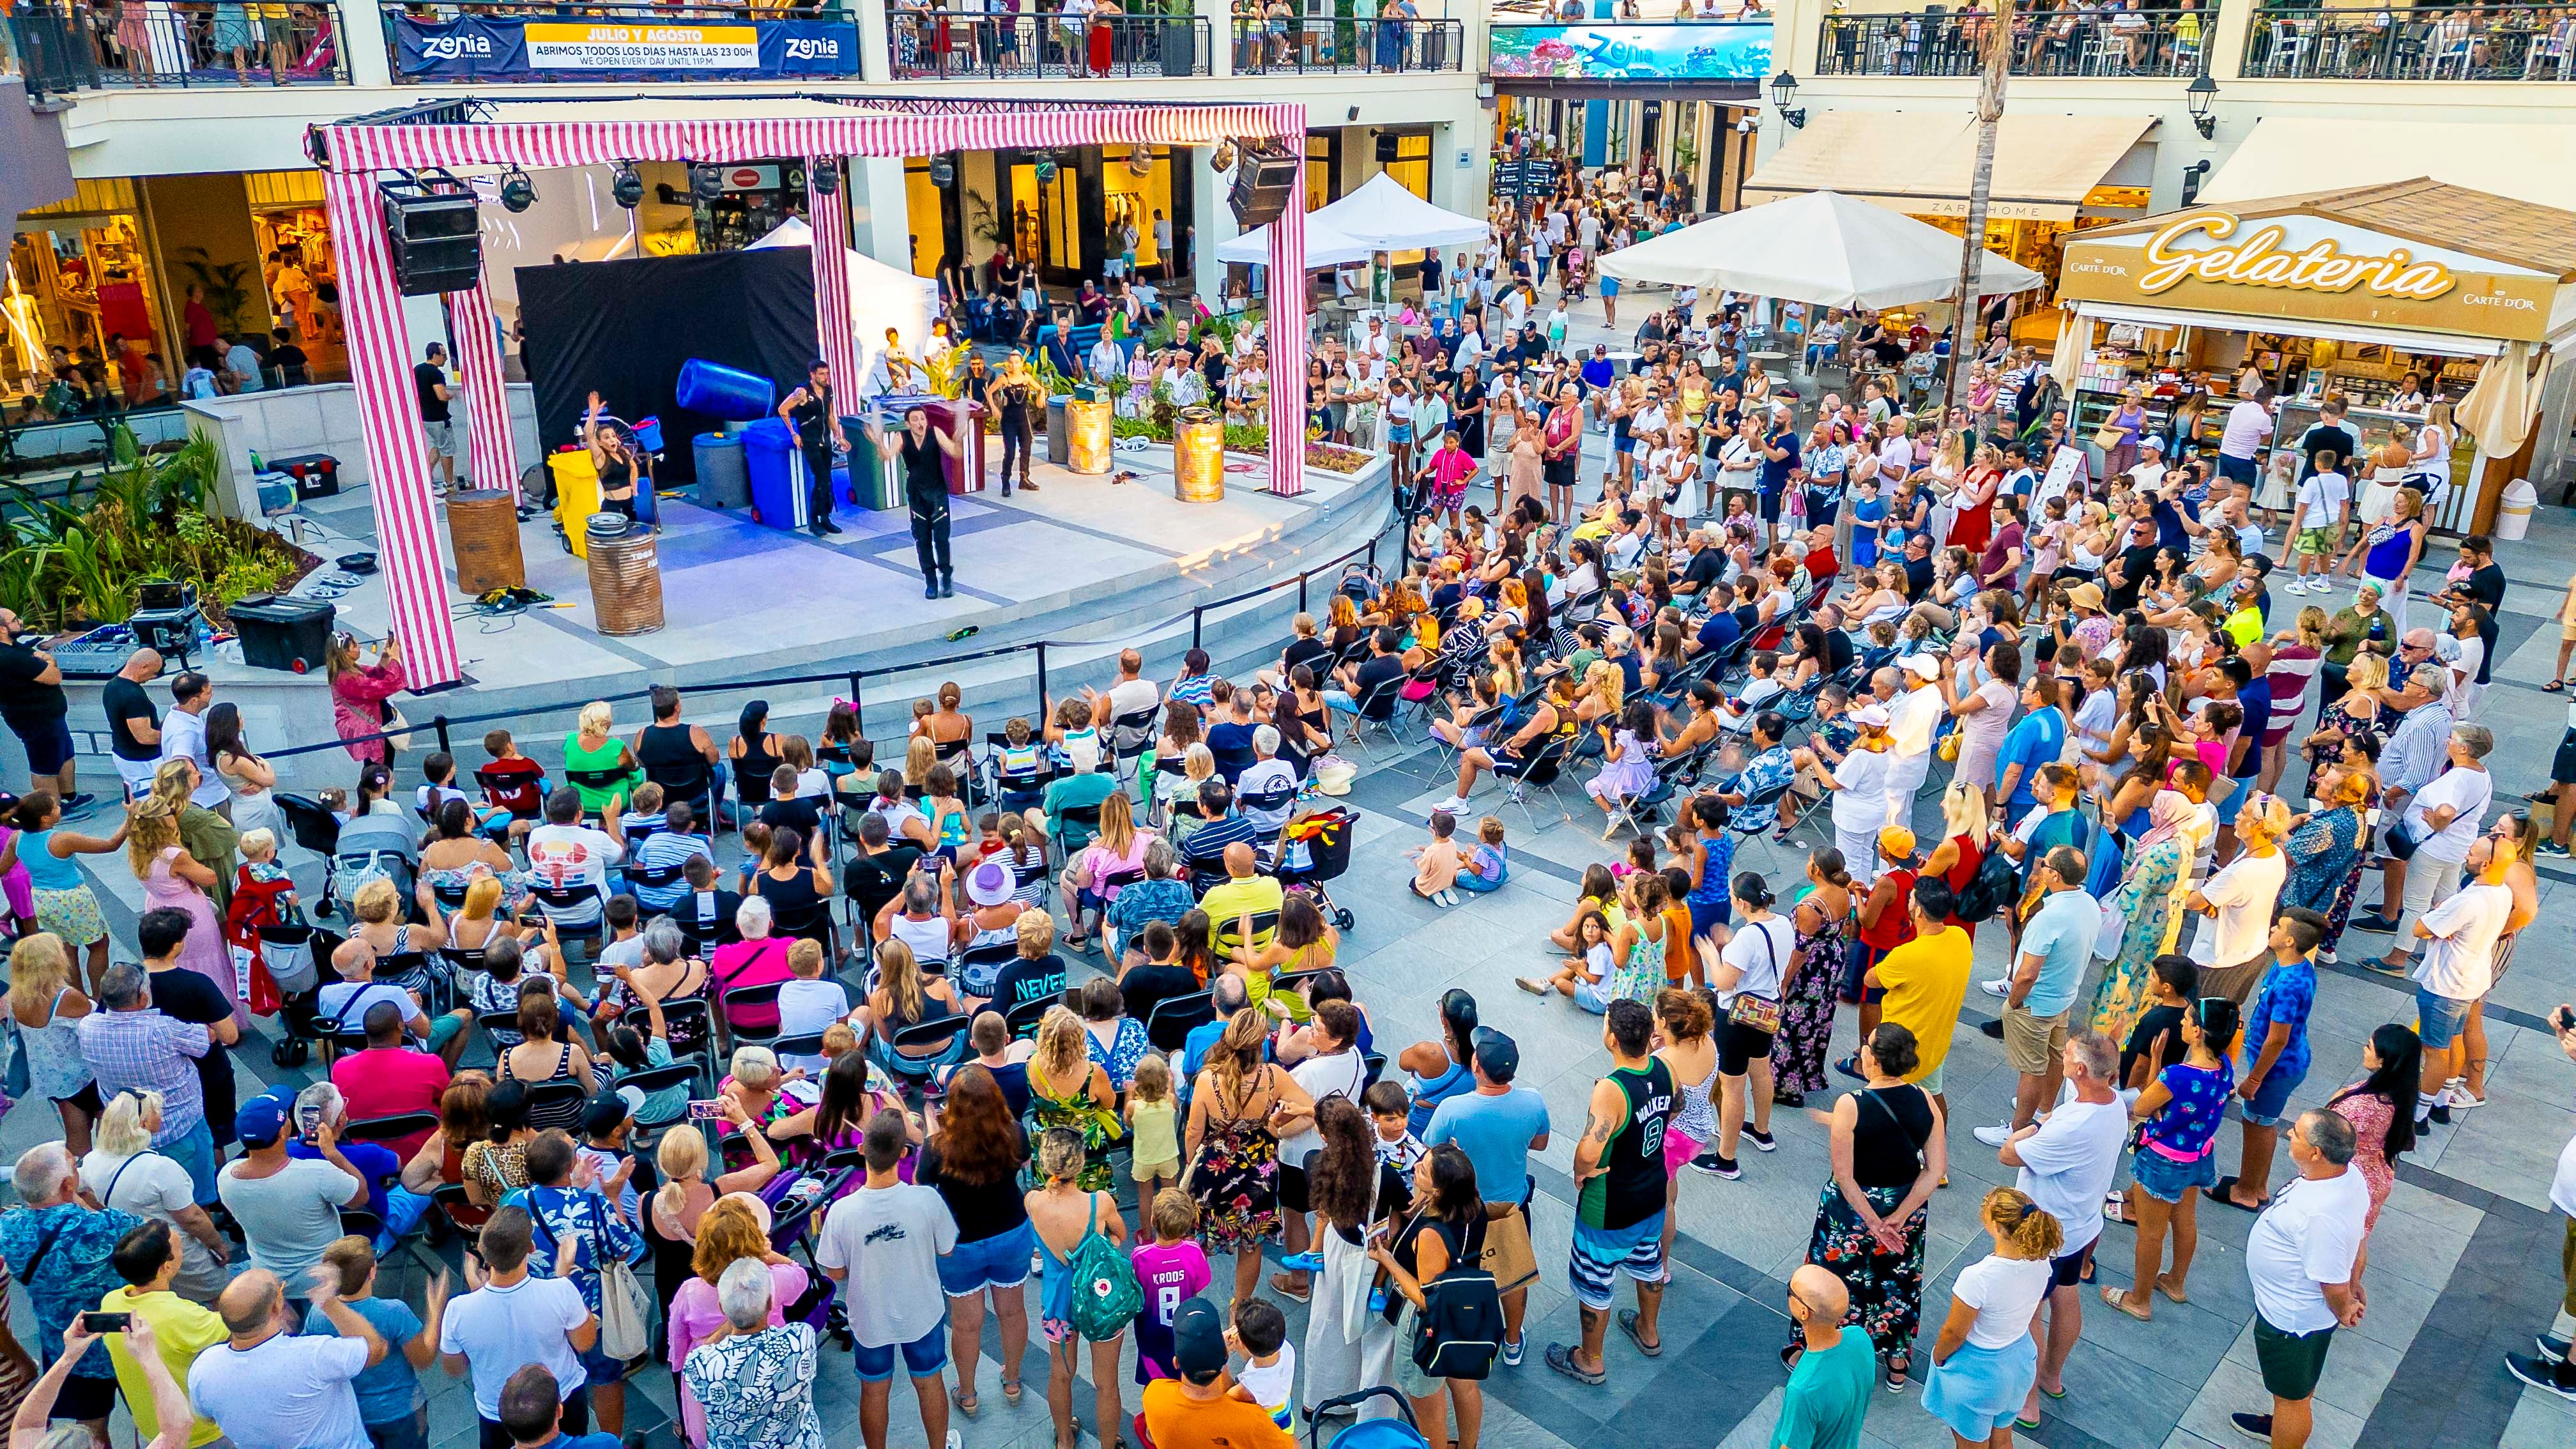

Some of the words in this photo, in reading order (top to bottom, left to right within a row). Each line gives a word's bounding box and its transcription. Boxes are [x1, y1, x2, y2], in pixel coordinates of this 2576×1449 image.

[587, 28, 629, 41] JULIO
[632, 29, 642, 41] Y
[647, 29, 703, 42] AGOSTO
[536, 45, 583, 56] ABRIMOS
[585, 46, 620, 56] TODOS
[622, 47, 641, 56] LOS
[643, 45, 666, 56] DÍAS
[668, 47, 699, 56] HASTA
[701, 48, 718, 56] LAS
[1931, 203, 1969, 213] ZAR
[1987, 206, 2040, 217] HOME
[2138, 215, 2452, 295] Gelateria
[2070, 262, 2100, 272] CARTE
[2103, 265, 2129, 277] D'OR
[2463, 293, 2501, 306] CARTE
[2504, 298, 2538, 312] D'OR
[1015, 972, 1066, 1001] NEVER
[1635, 1095, 1671, 1124] WALKER
[1642, 1116, 1664, 1158] 8
[1153, 1269, 1184, 1285] KROOS
[1158, 1285, 1180, 1327] 8
